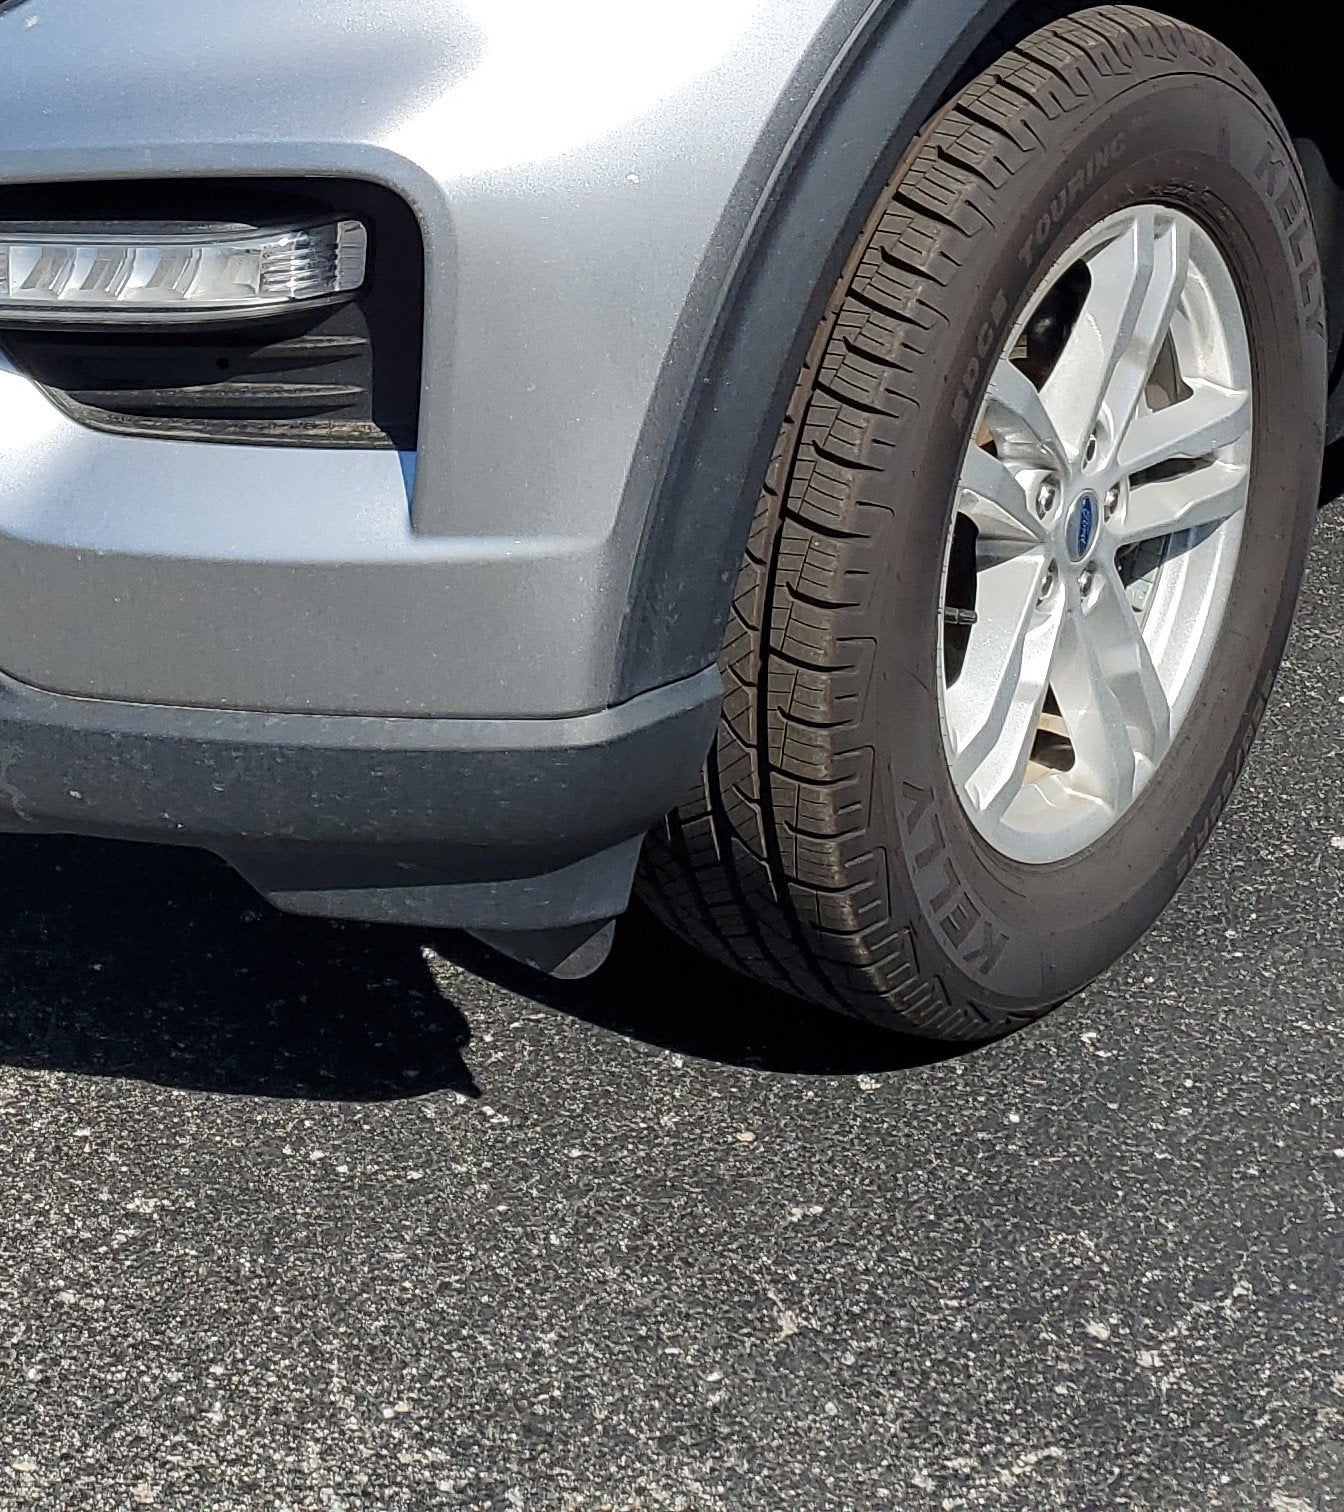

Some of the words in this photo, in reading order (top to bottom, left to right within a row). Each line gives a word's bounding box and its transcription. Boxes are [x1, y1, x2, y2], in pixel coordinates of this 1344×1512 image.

[952, 287, 1008, 425] EDGE
[1017, 131, 1127, 268] TOURING
[1255, 143, 1327, 338] KELLY
[902, 780, 1010, 976] KELLY
